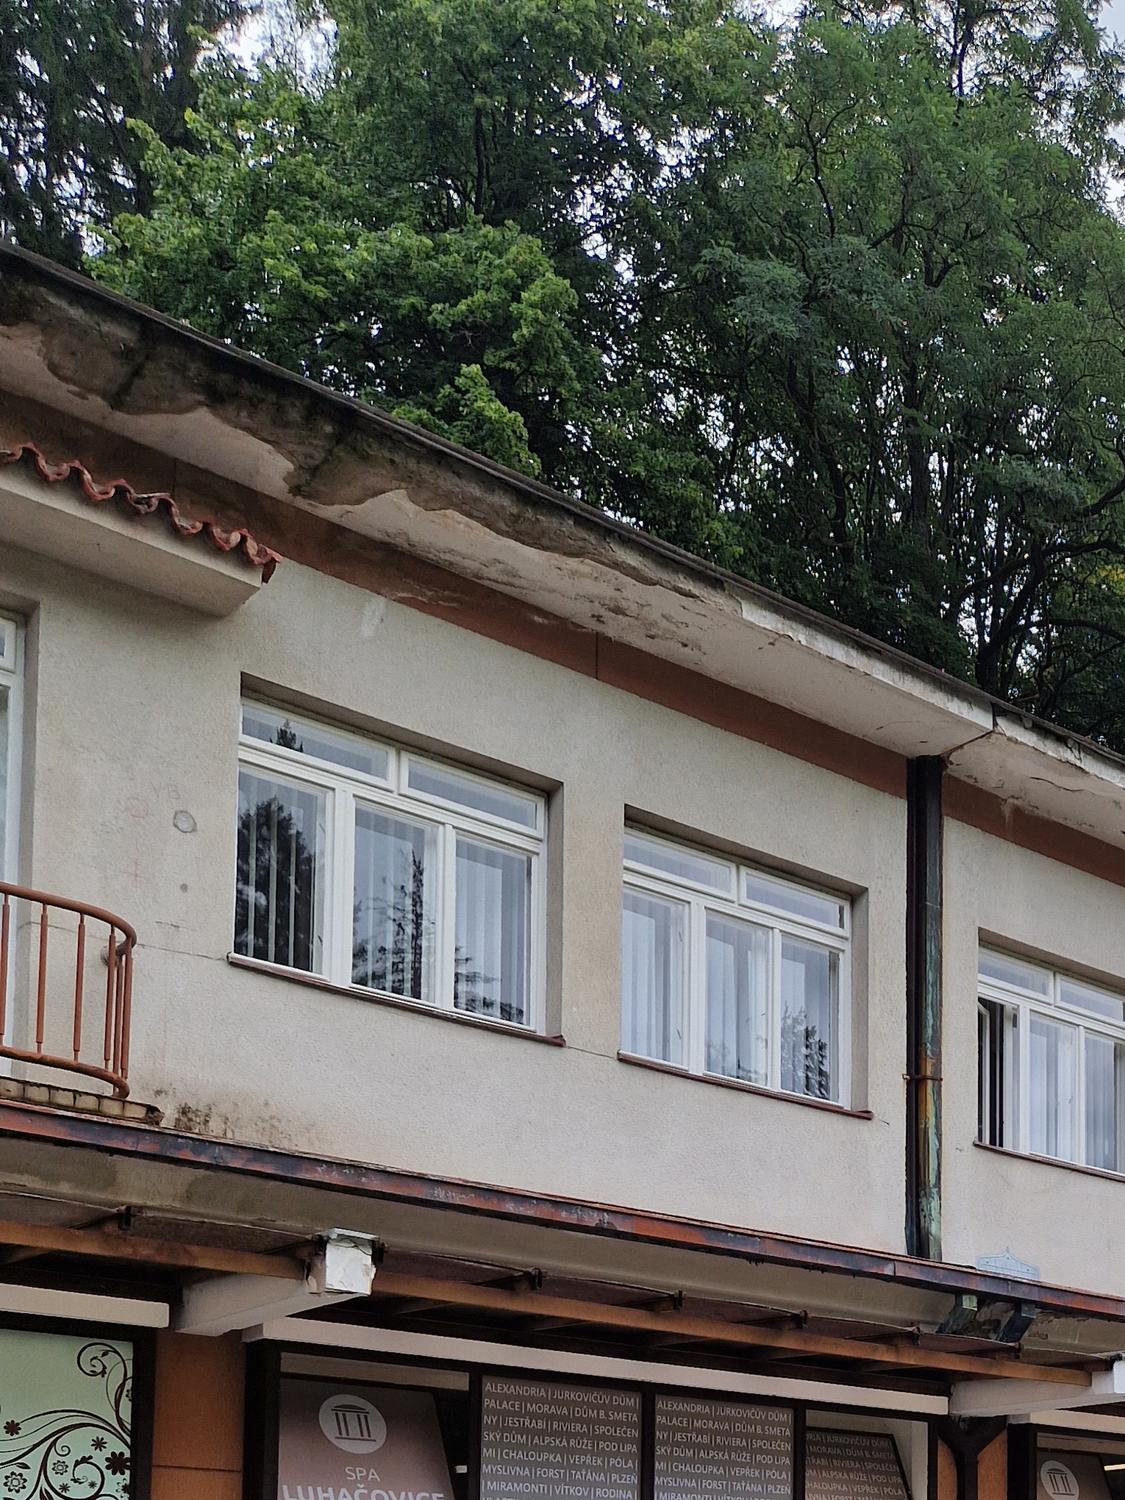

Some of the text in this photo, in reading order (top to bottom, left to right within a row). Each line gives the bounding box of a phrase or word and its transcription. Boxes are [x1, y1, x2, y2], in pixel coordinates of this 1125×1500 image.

[485, 1382, 546, 1397] ALEXANDRIA
[613, 1395, 634, 1406] DŮM
[484, 1399, 520, 1411] PALACE
[527, 1403, 568, 1416] MORAVA
[575, 1405, 597, 1418] DŮM
[609, 1411, 638, 1422] SMETA
[657, 1401, 710, 1414] ALEXANDRIA
[768, 1411, 787, 1422] DŮM
[484, 1415, 638, 1437] NY JESTŘABÍ RIVIERA SPOLEČEN
[656, 1416, 688, 1427] PALACE
[694, 1419, 729, 1430] MORAVA
[735, 1421, 755, 1433] DŮM
[765, 1426, 790, 1437] SMETA
[484, 1430, 501, 1442] SKÝ
[503, 1431, 526, 1444] DŮM
[533, 1435, 567, 1448] ALPSKÁ
[599, 1443, 618, 1452] POD
[620, 1444, 637, 1453] LIPA
[656, 1431, 669, 1440] NY
[716, 1436, 746, 1447] RIVIERA
[483, 1448, 495, 1457] MI
[503, 1449, 561, 1463] CHALOUPKA
[673, 1446, 693, 1458] DŮM
[700, 1449, 729, 1461] ALPSKÁ
[757, 1455, 772, 1464] POD
[345, 1466, 380, 1481] SPA
[483, 1464, 529, 1476] MYSLIVNA
[536, 1468, 565, 1478] FORST
[655, 1462, 667, 1471] MI
[672, 1462, 724, 1475] CHALOUPKA
[487, 1480, 632, 1499] MIRAMONTI VÍTKOV RODINA
[655, 1476, 696, 1488] MYSLIVNA
[702, 1480, 727, 1490] FORST
[806, 1482, 848, 1491] HALOUPKA
